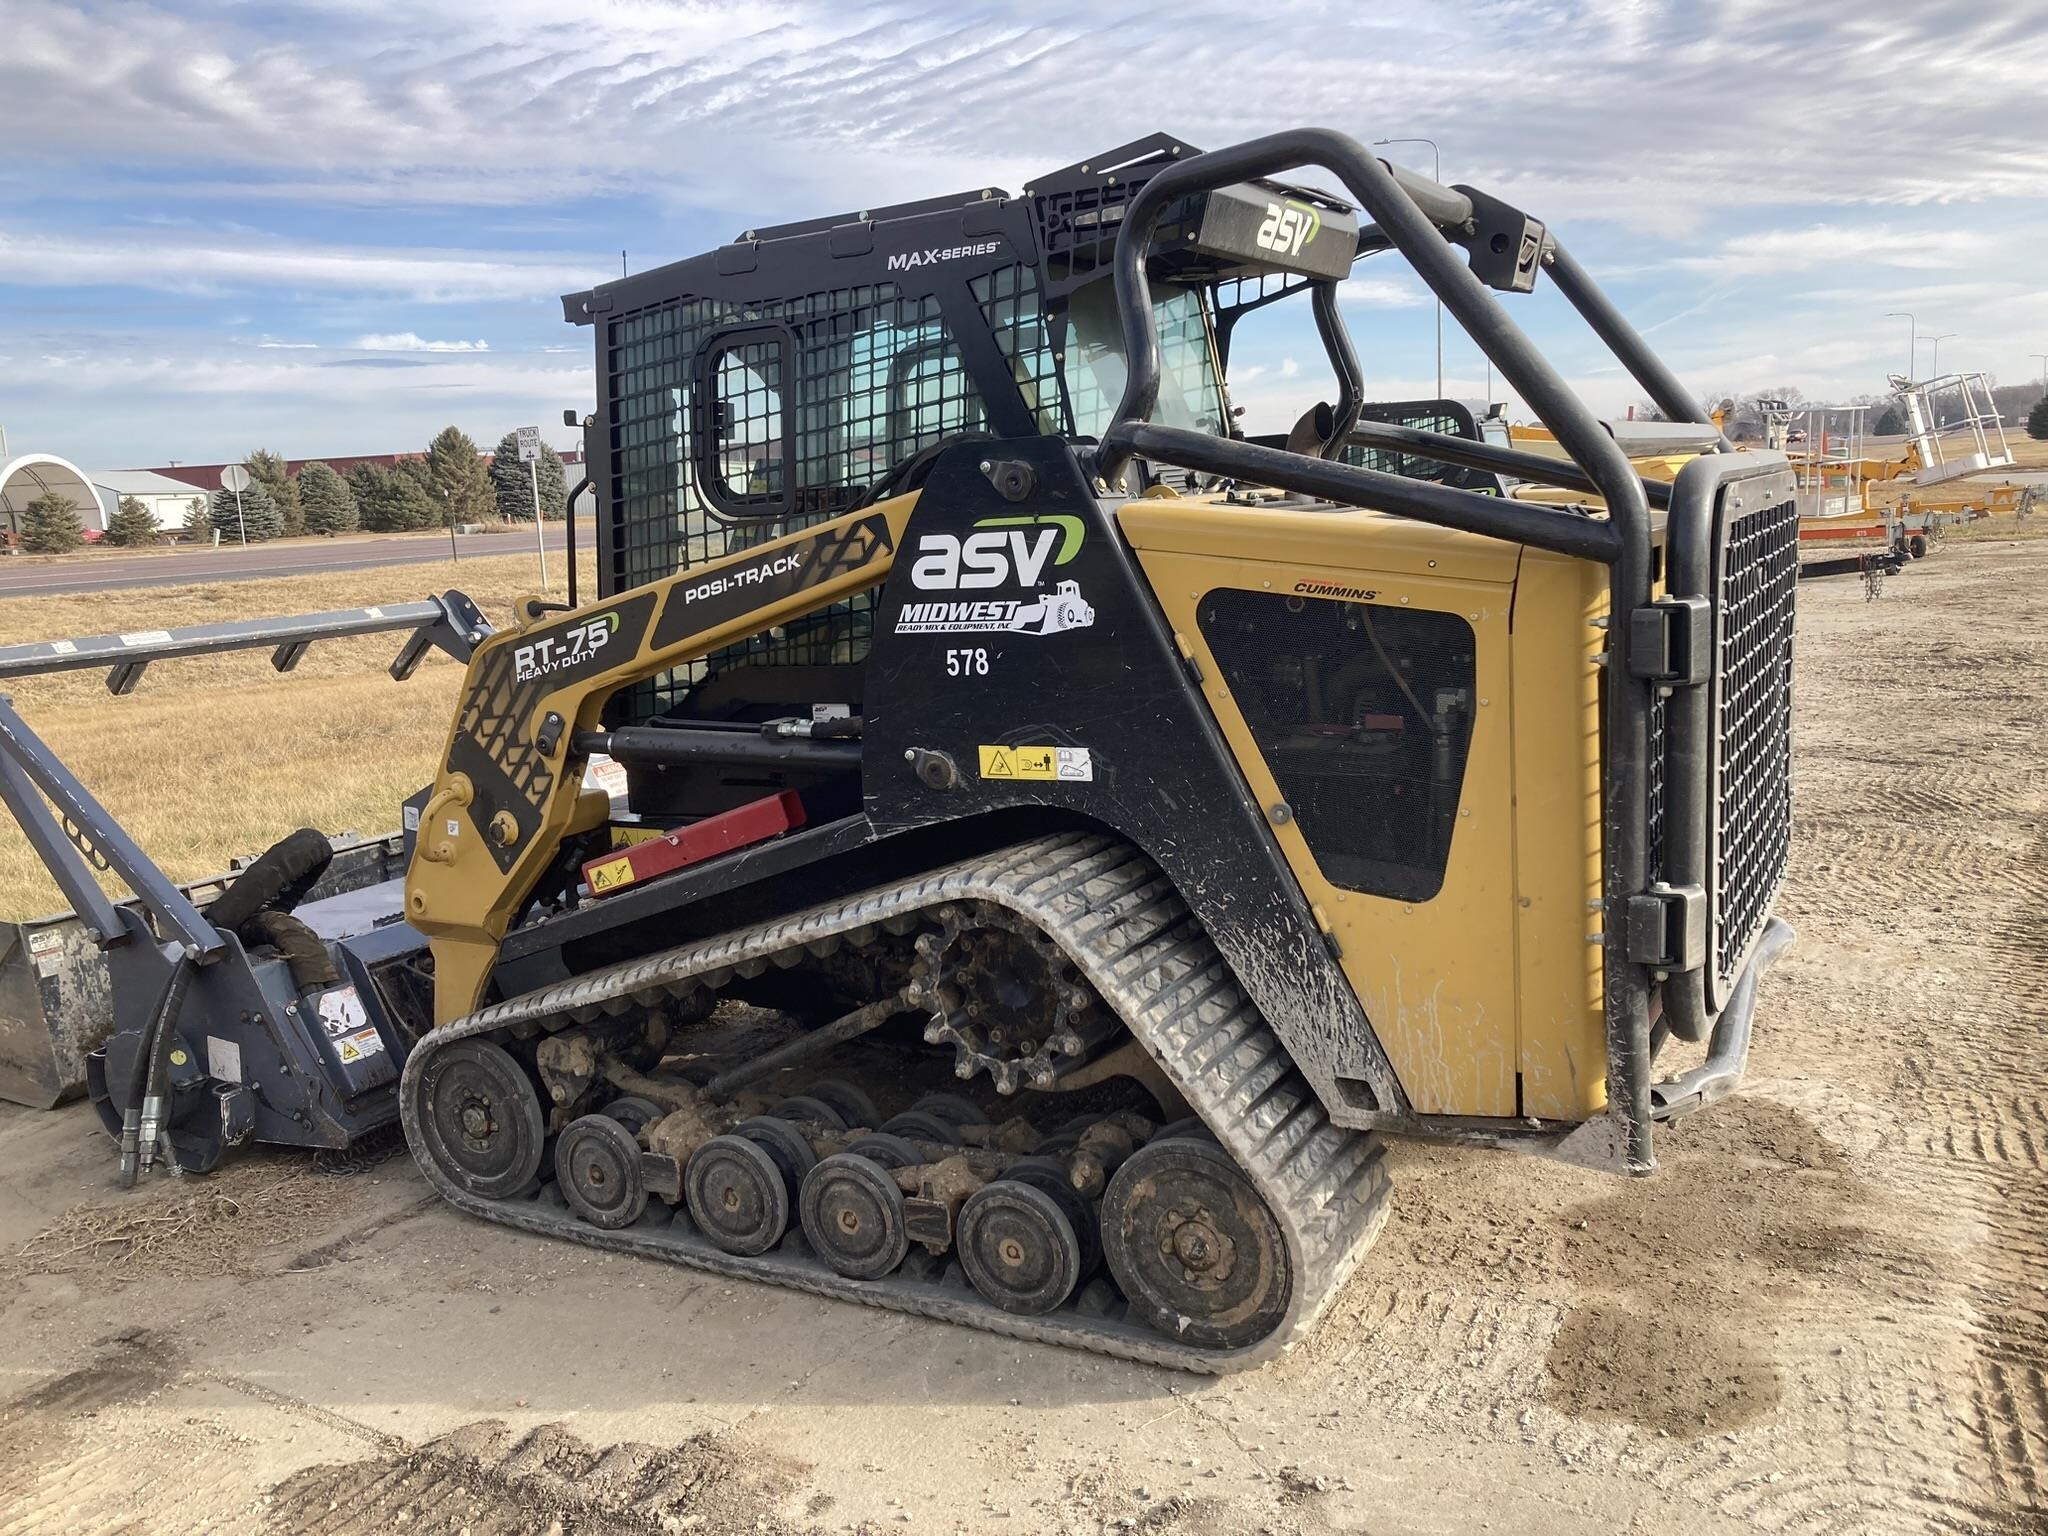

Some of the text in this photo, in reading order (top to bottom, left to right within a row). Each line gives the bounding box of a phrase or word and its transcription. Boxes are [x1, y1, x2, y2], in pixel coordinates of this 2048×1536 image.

[519, 429, 538, 438] TRUCK
[520, 439, 538, 448] ROUTE
[685, 553, 801, 605] POSI-TRACK
[1294, 583, 1377, 600] CUMMINS
[898, 600, 1023, 622] MIDWEST
[897, 624, 924, 632] READY
[924, 623, 939, 631] MIX
[940, 623, 947, 631] &
[514, 619, 609, 674] RT-75
[516, 648, 597, 683] HEAVY DUTY
[946, 648, 989, 676] 578
